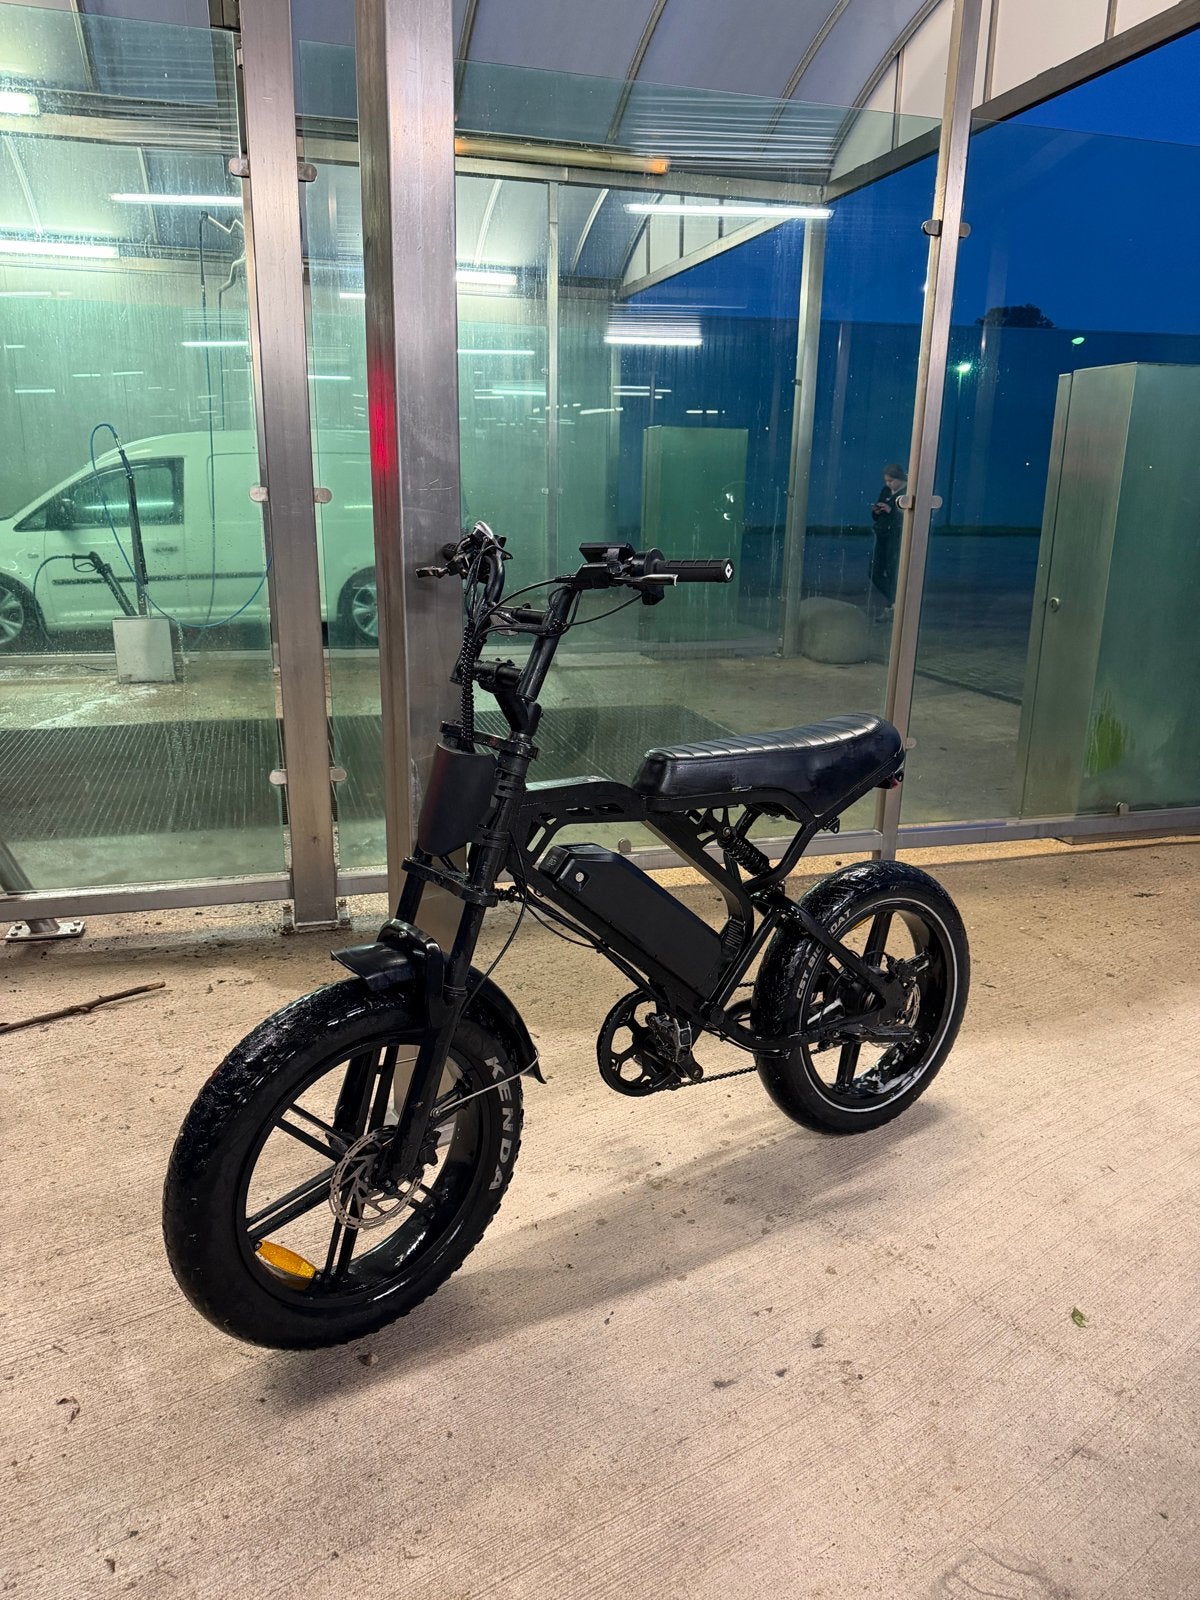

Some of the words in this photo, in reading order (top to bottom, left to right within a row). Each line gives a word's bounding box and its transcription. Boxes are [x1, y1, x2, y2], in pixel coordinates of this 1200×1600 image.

[796, 970, 809, 999] CST
[828, 908, 851, 934] OAT
[484, 1056, 514, 1190] KENDA
